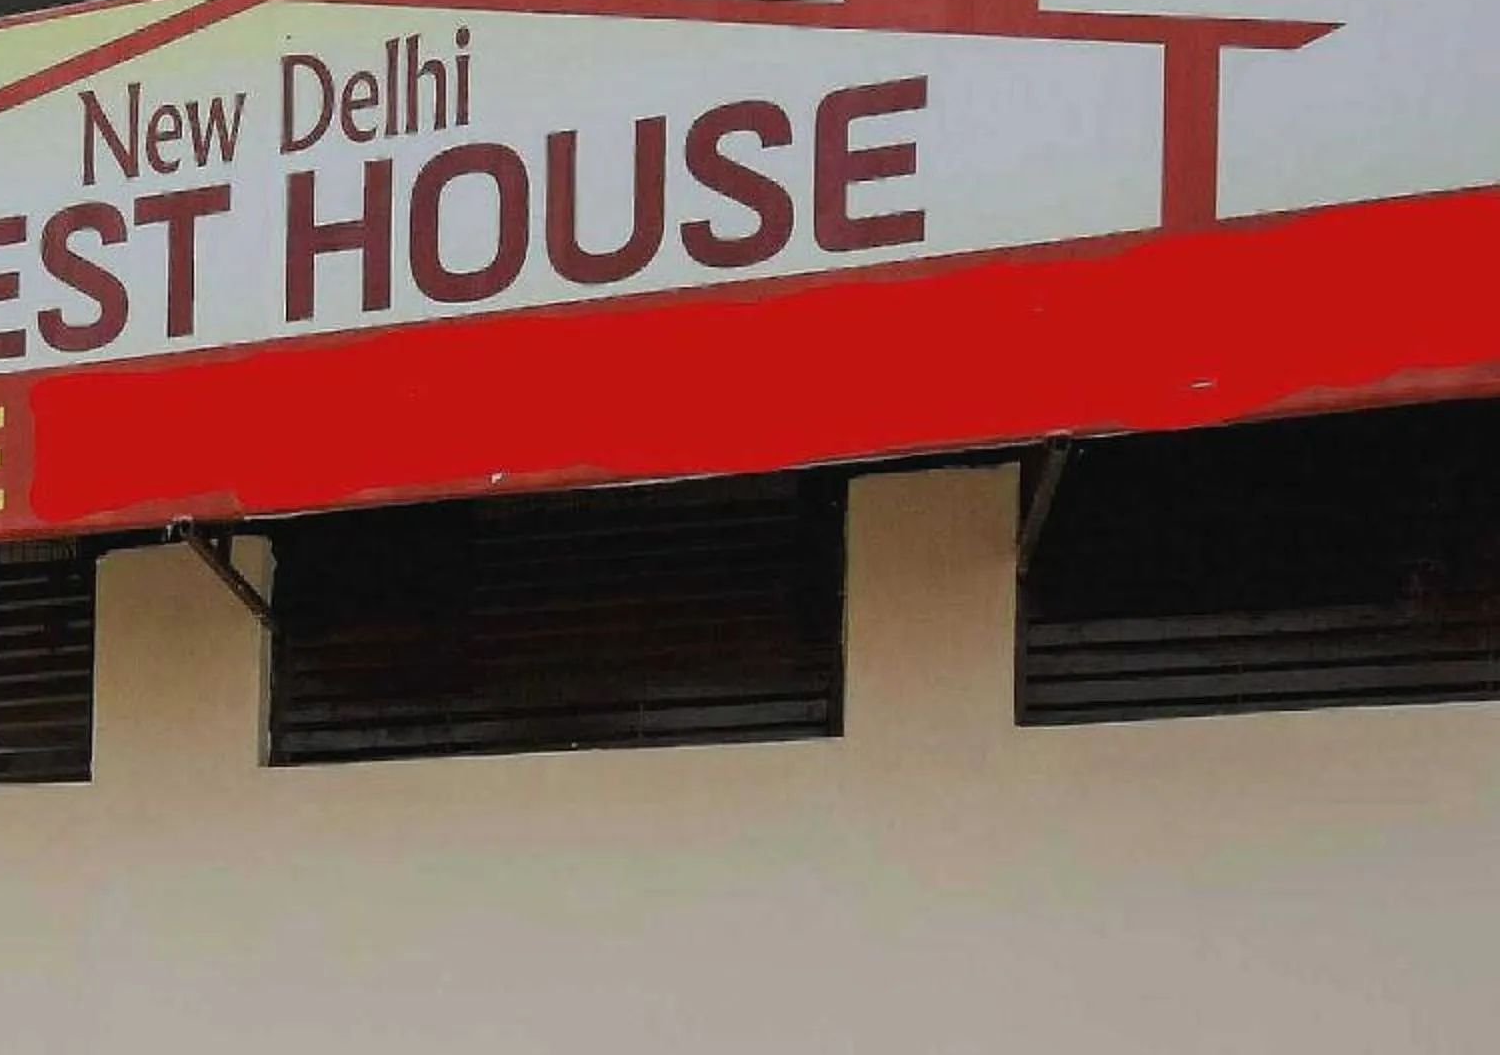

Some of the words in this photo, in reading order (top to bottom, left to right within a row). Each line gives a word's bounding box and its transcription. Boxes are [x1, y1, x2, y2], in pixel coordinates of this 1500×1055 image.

[79, 82, 247, 186] New
[280, 27, 473, 155] Delhi
[284, 75, 928, 323] HOUSE
